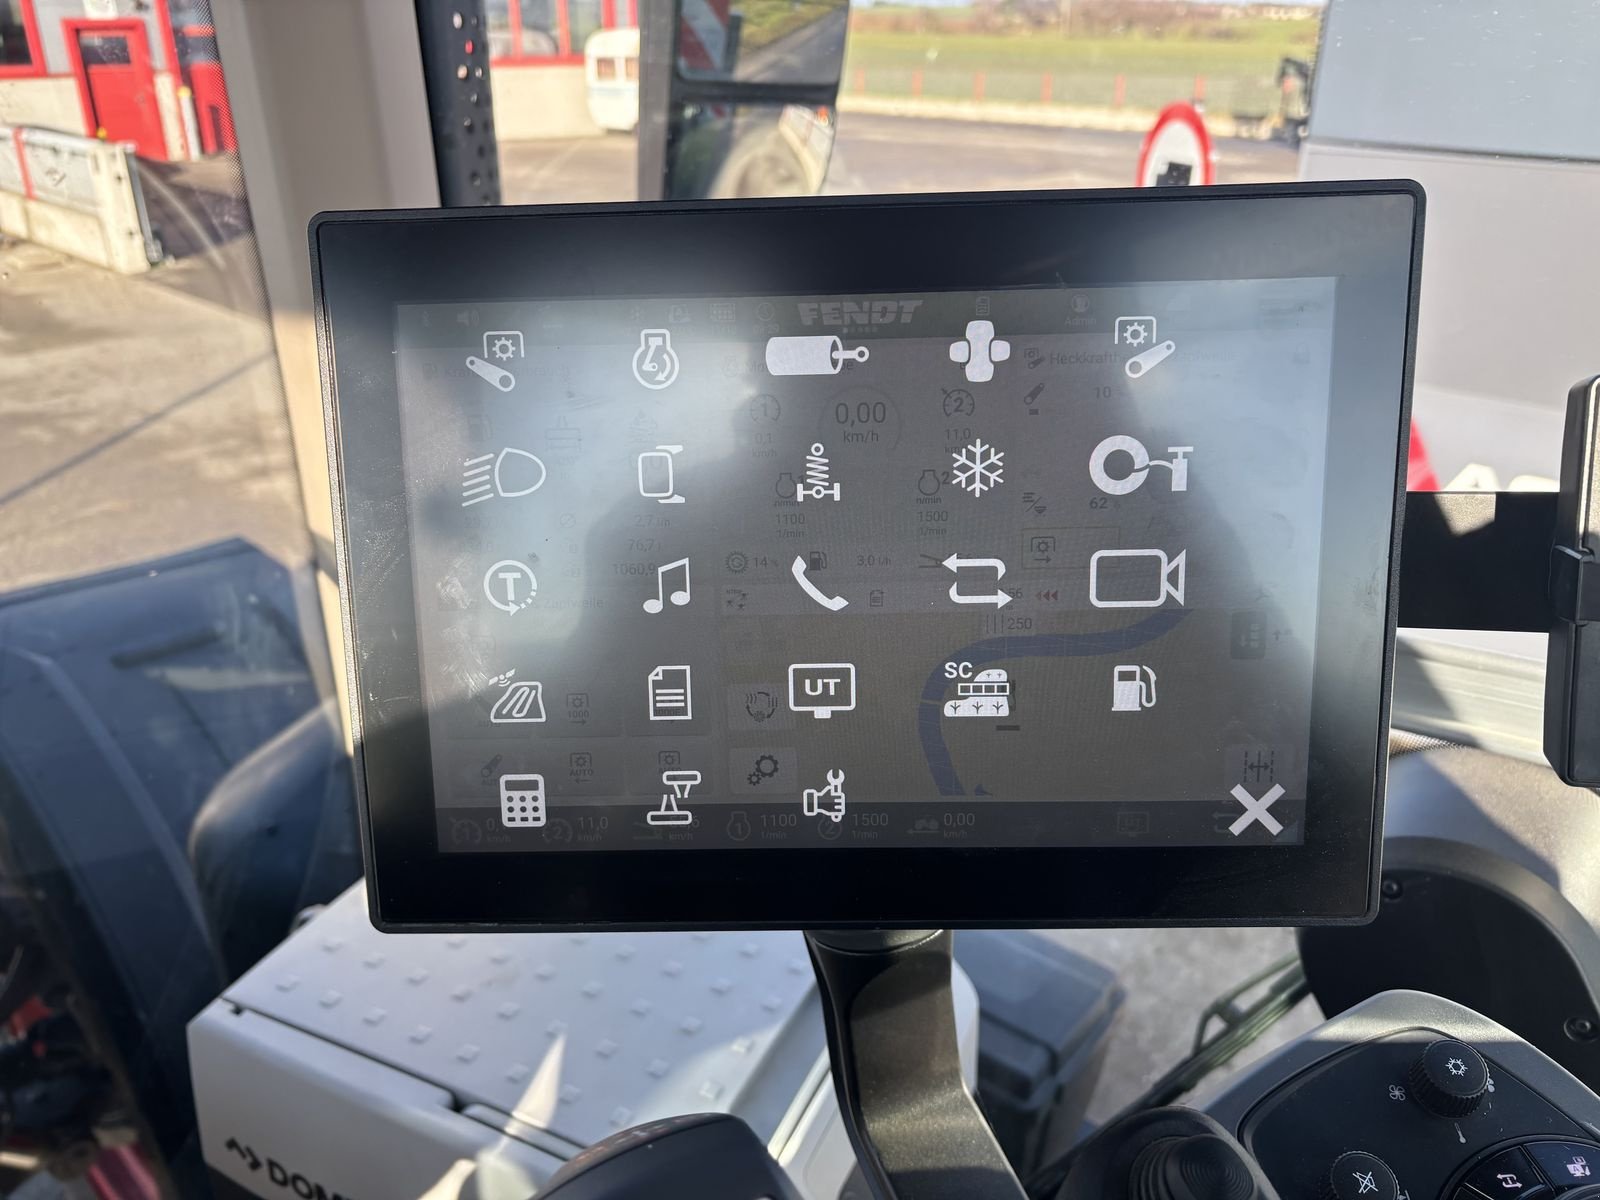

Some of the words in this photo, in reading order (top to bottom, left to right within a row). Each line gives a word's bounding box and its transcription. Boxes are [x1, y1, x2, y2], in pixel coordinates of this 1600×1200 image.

[797, 299, 923, 326] FENDT
[834, 401, 887, 427] 0,00
[843, 429, 879, 443] km/h
[944, 427, 972, 442] 11,0
[1089, 497, 1108, 511] 62
[775, 512, 806, 526] 1100
[917, 510, 949, 524] 1500
[753, 556, 768, 569] 14
[856, 554, 876, 569] 3,0
[612, 562, 657, 577] 1060,9
[1006, 616, 1033, 631] 250
[943, 660, 975, 681] SC
[803, 678, 842, 697] UT
[567, 709, 590, 719] 1000
[569, 768, 595, 778] AUTO
[577, 815, 609, 832] 11,0
[760, 812, 798, 828] 1100
[852, 812, 889, 828] 1500
[943, 812, 976, 829] 0,00
